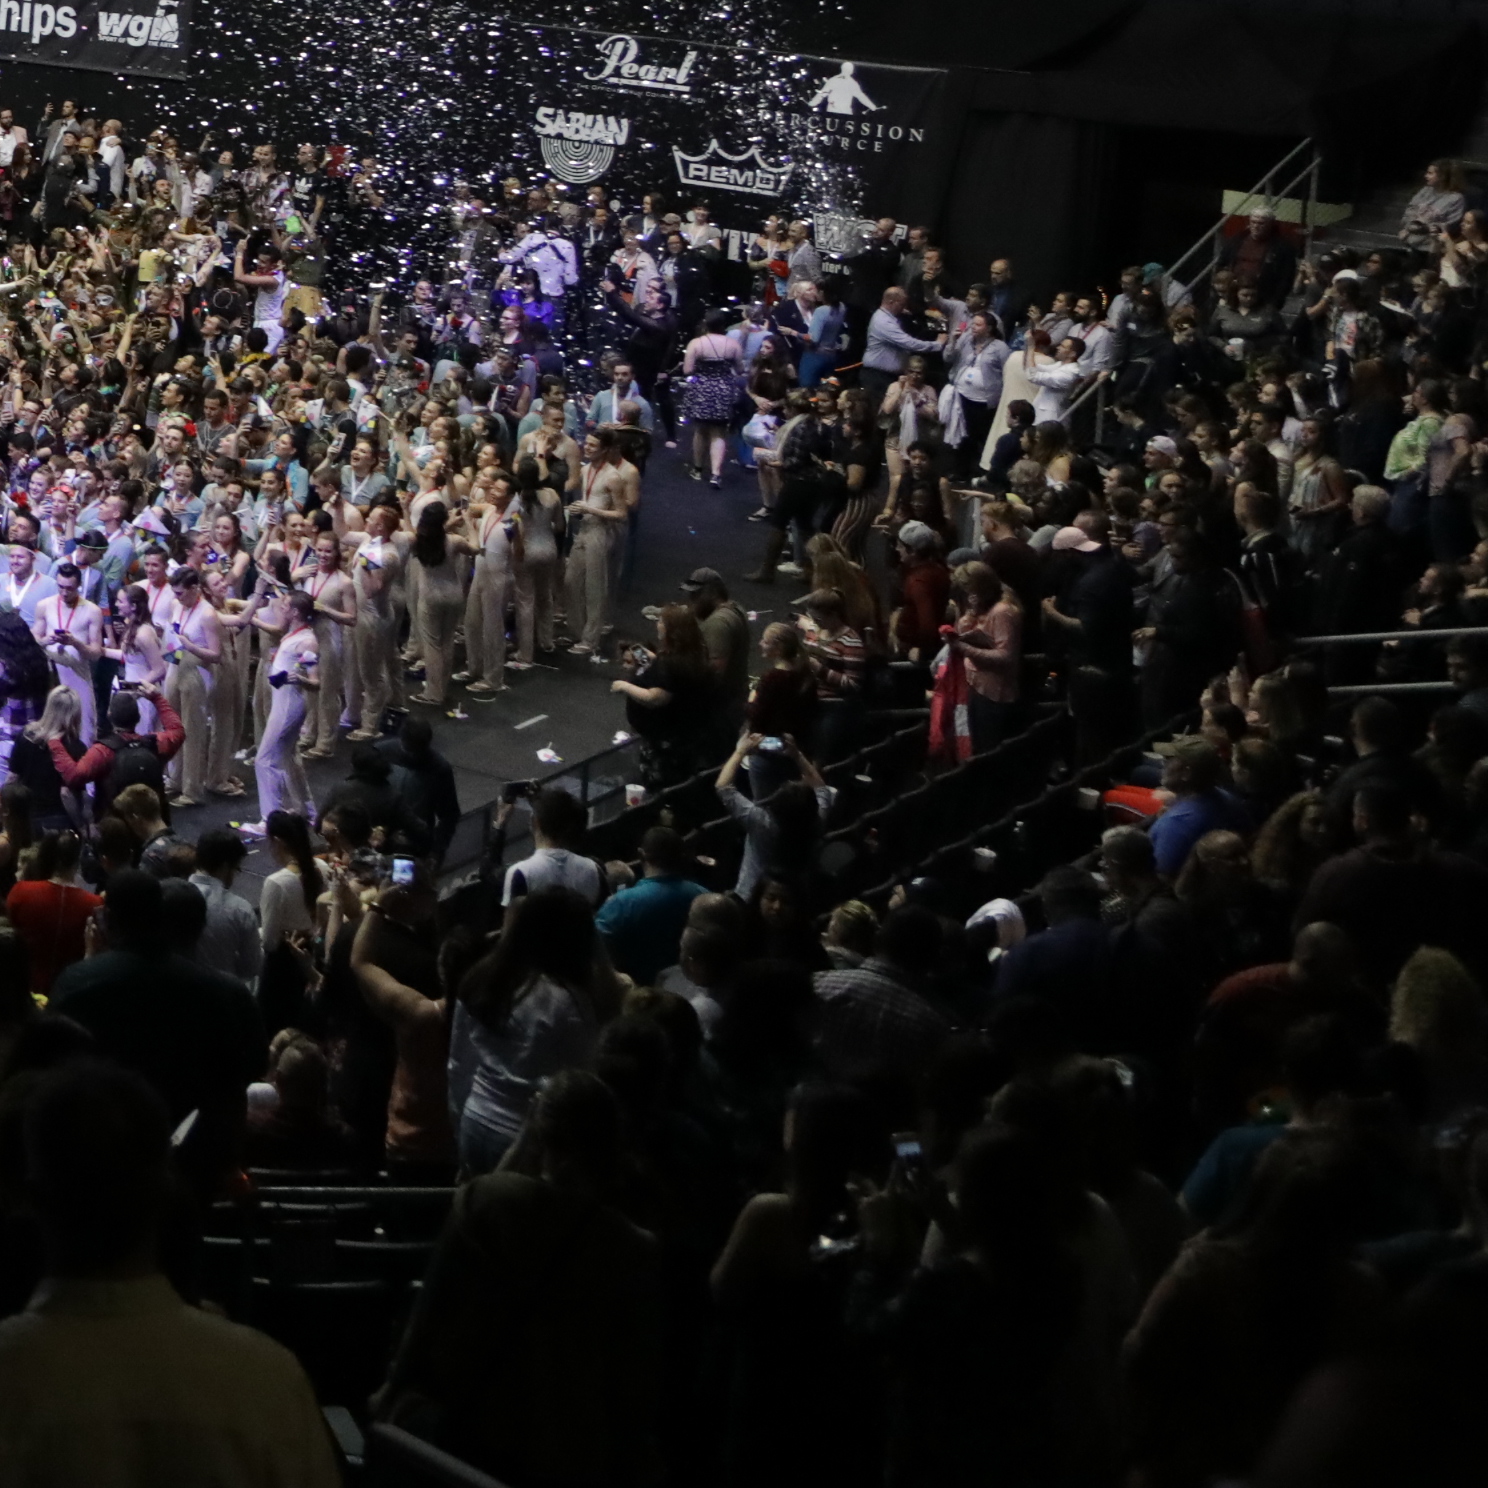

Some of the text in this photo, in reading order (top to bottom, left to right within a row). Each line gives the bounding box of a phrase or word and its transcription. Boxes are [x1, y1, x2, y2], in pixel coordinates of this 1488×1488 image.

[583, 34, 697, 84] Pearl
[533, 106, 630, 146] SABIAN
[758, 109, 924, 142] PERCUSSION
[688, 163, 775, 191] REMO
